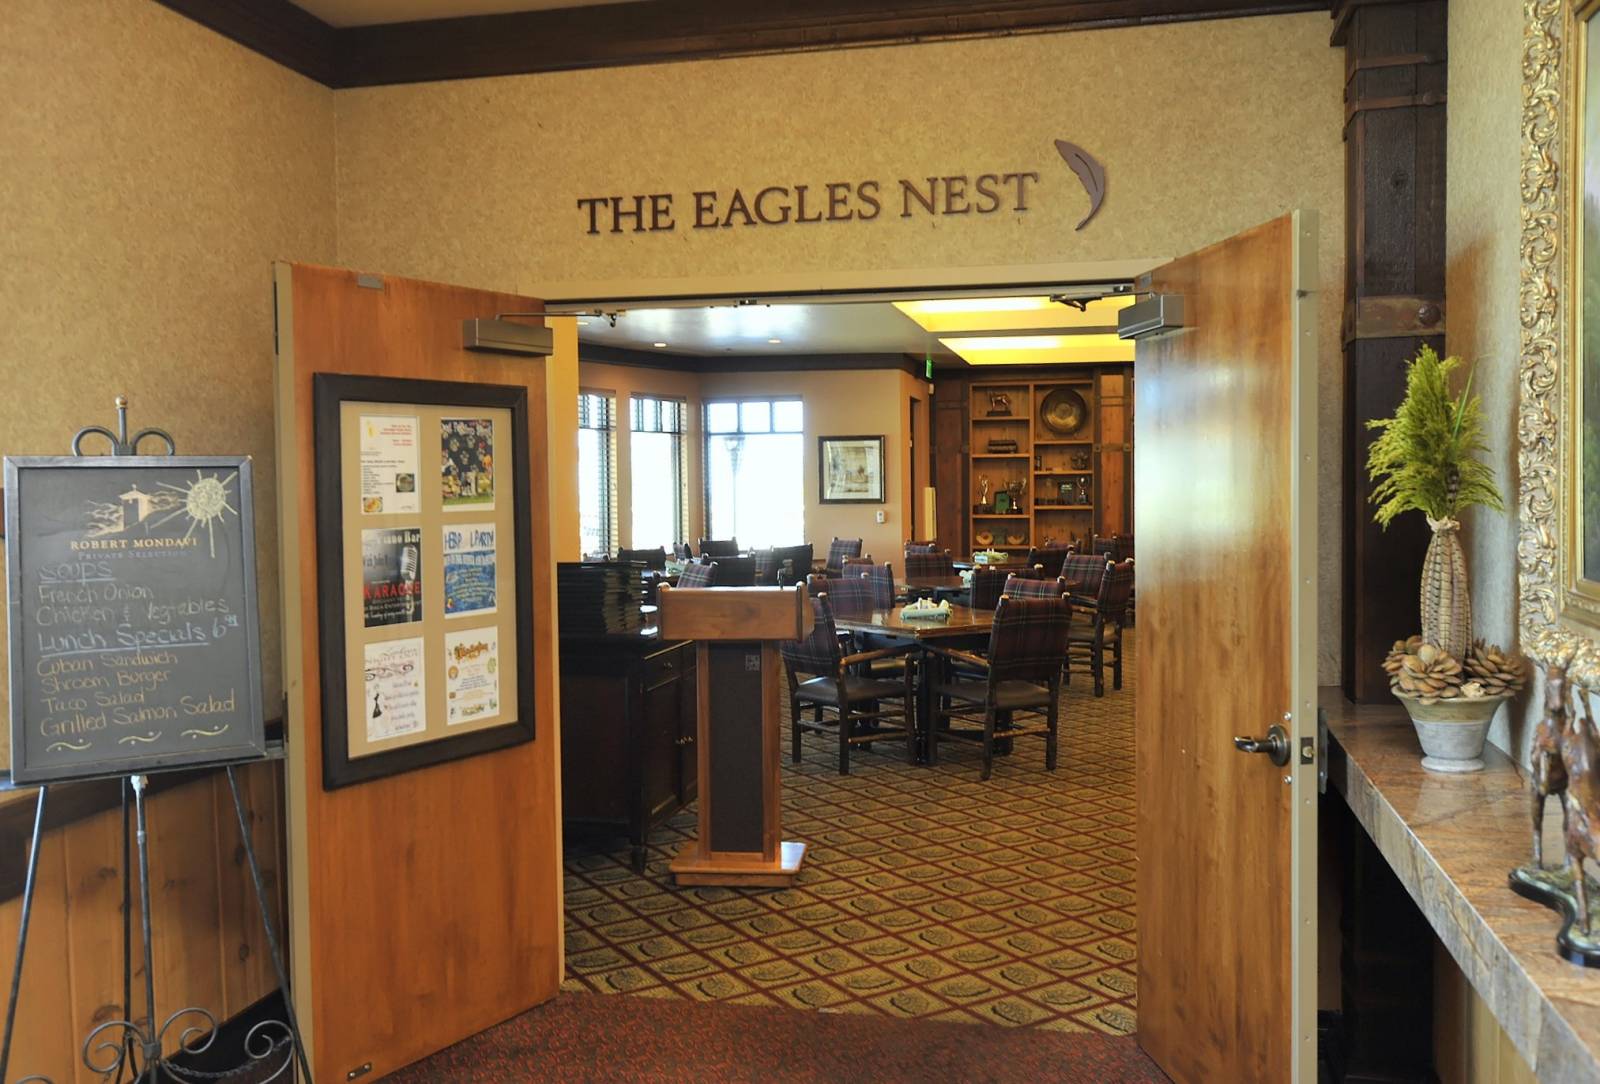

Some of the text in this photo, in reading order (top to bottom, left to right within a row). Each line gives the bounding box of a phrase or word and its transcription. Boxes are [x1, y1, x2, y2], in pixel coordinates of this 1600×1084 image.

[577, 172, 1039, 234] THE EAGLES NEST
[70, 537, 197, 550] ROBERT MONDAVI
[38, 583, 154, 604] French Onion
[36, 605, 114, 626] Chicken
[37, 628, 107, 652] Lunch
[116, 622, 206, 651] Specials
[37, 651, 178, 677] Cuban Sandwich
[41, 669, 172, 695] Shroom Burger
[40, 687, 145, 715] Taco Salad
[40, 687, 236, 737] Grilled Salmon Salad
